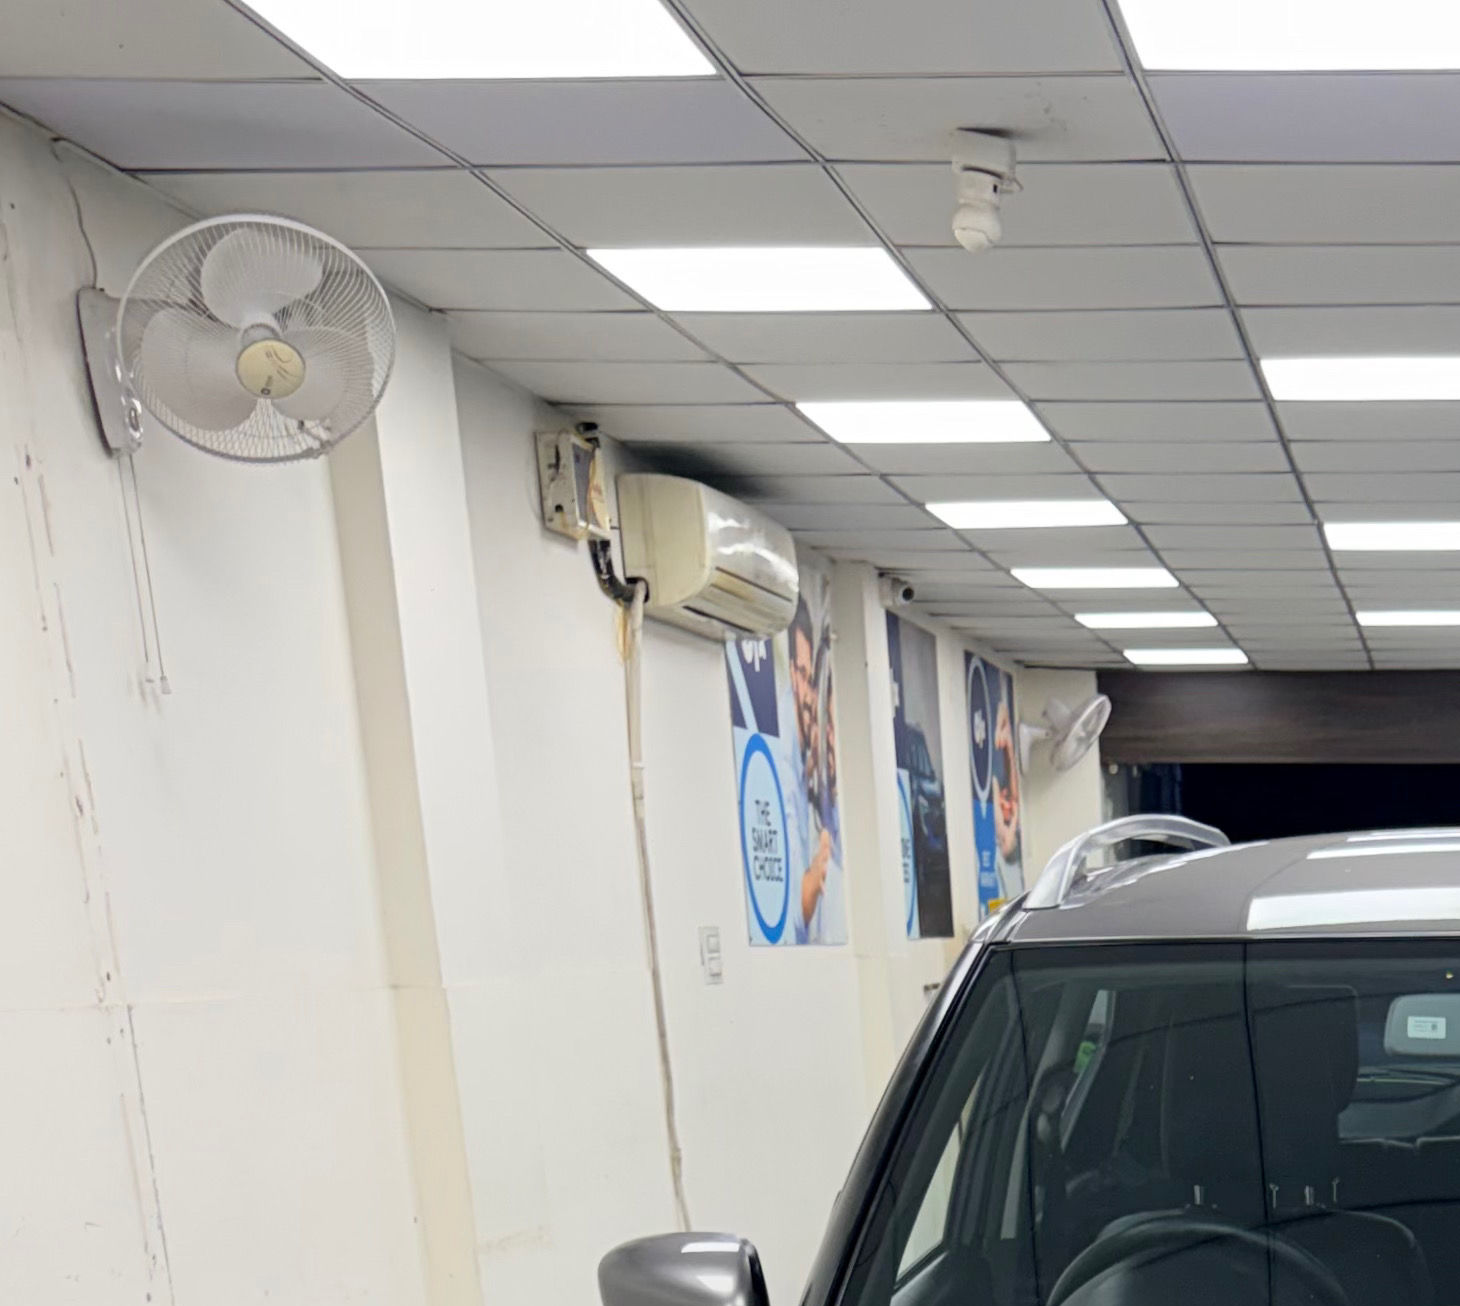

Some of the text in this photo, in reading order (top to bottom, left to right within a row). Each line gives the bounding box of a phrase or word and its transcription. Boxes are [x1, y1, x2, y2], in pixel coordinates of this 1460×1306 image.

[754, 799, 772, 827] THE
[751, 827, 778, 855] SMART
[753, 854, 784, 882] CHOICE
